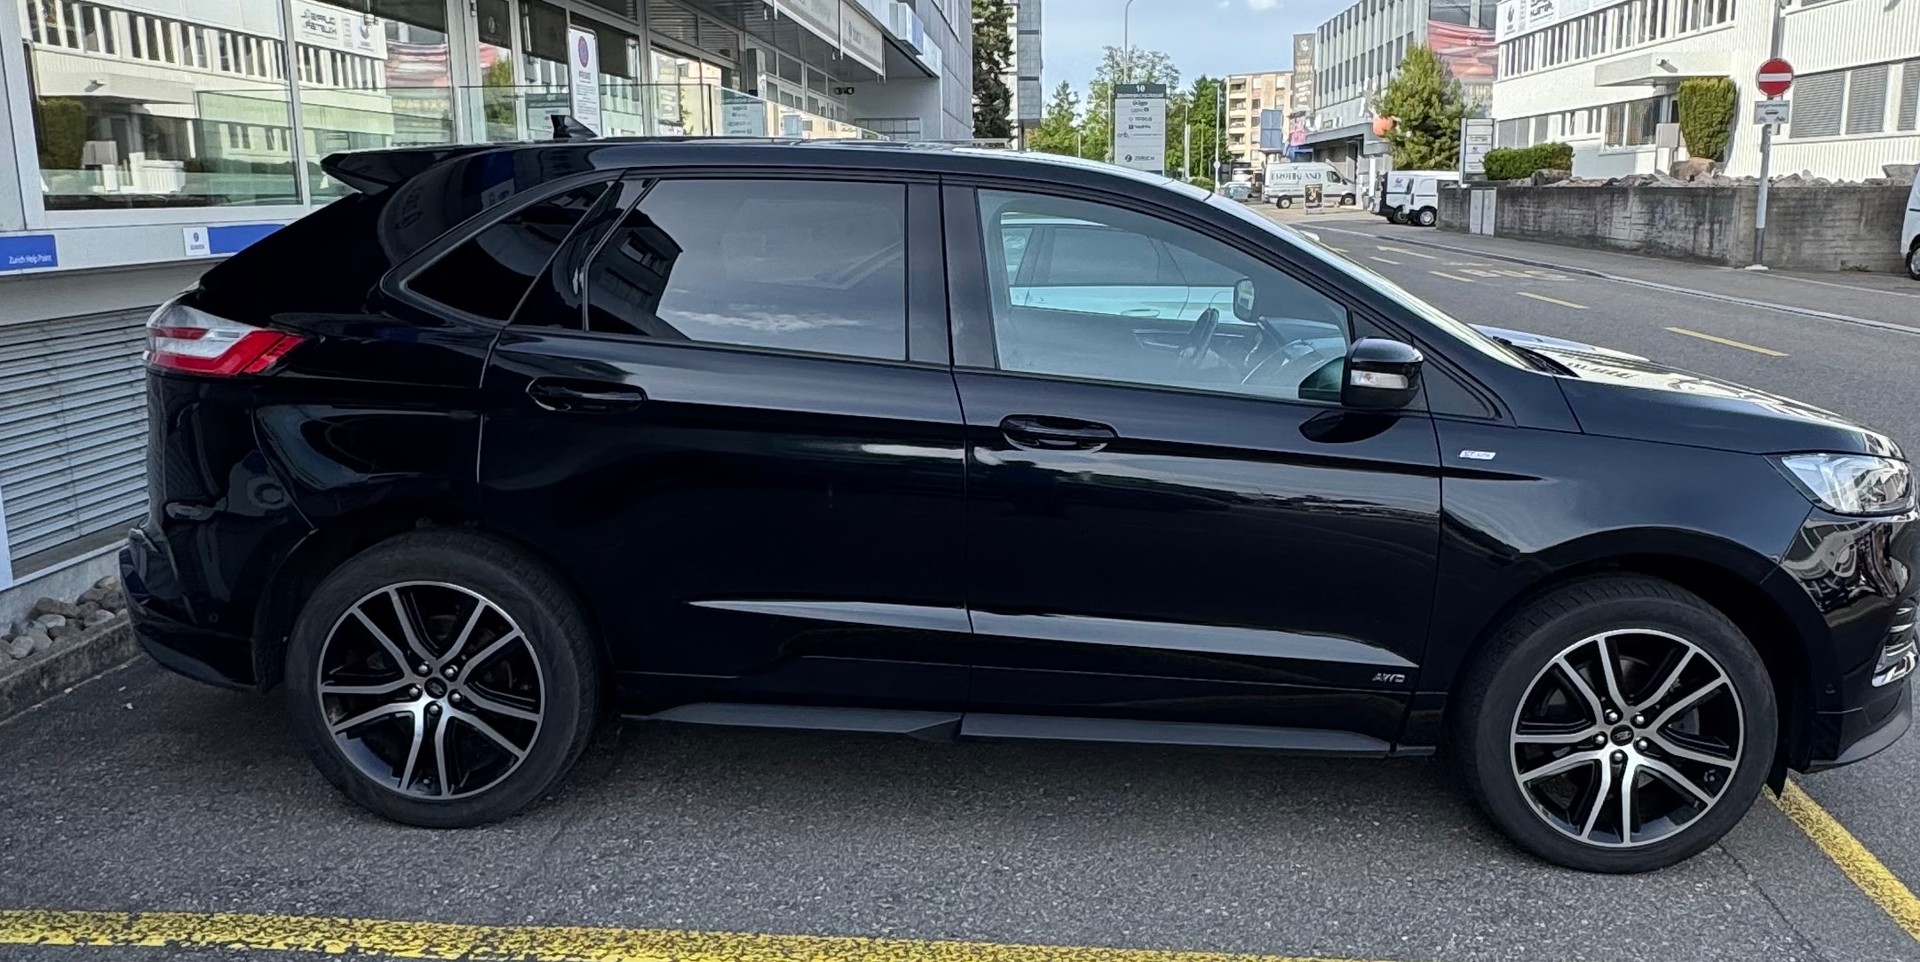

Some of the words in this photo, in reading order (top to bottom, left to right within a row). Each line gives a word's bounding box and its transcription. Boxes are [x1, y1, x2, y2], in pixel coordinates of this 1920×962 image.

[8, 256, 26, 264] Zurich
[26, 255, 37, 264] Help
[38, 254, 52, 262] Point
[1372, 672, 1406, 683] AWD
